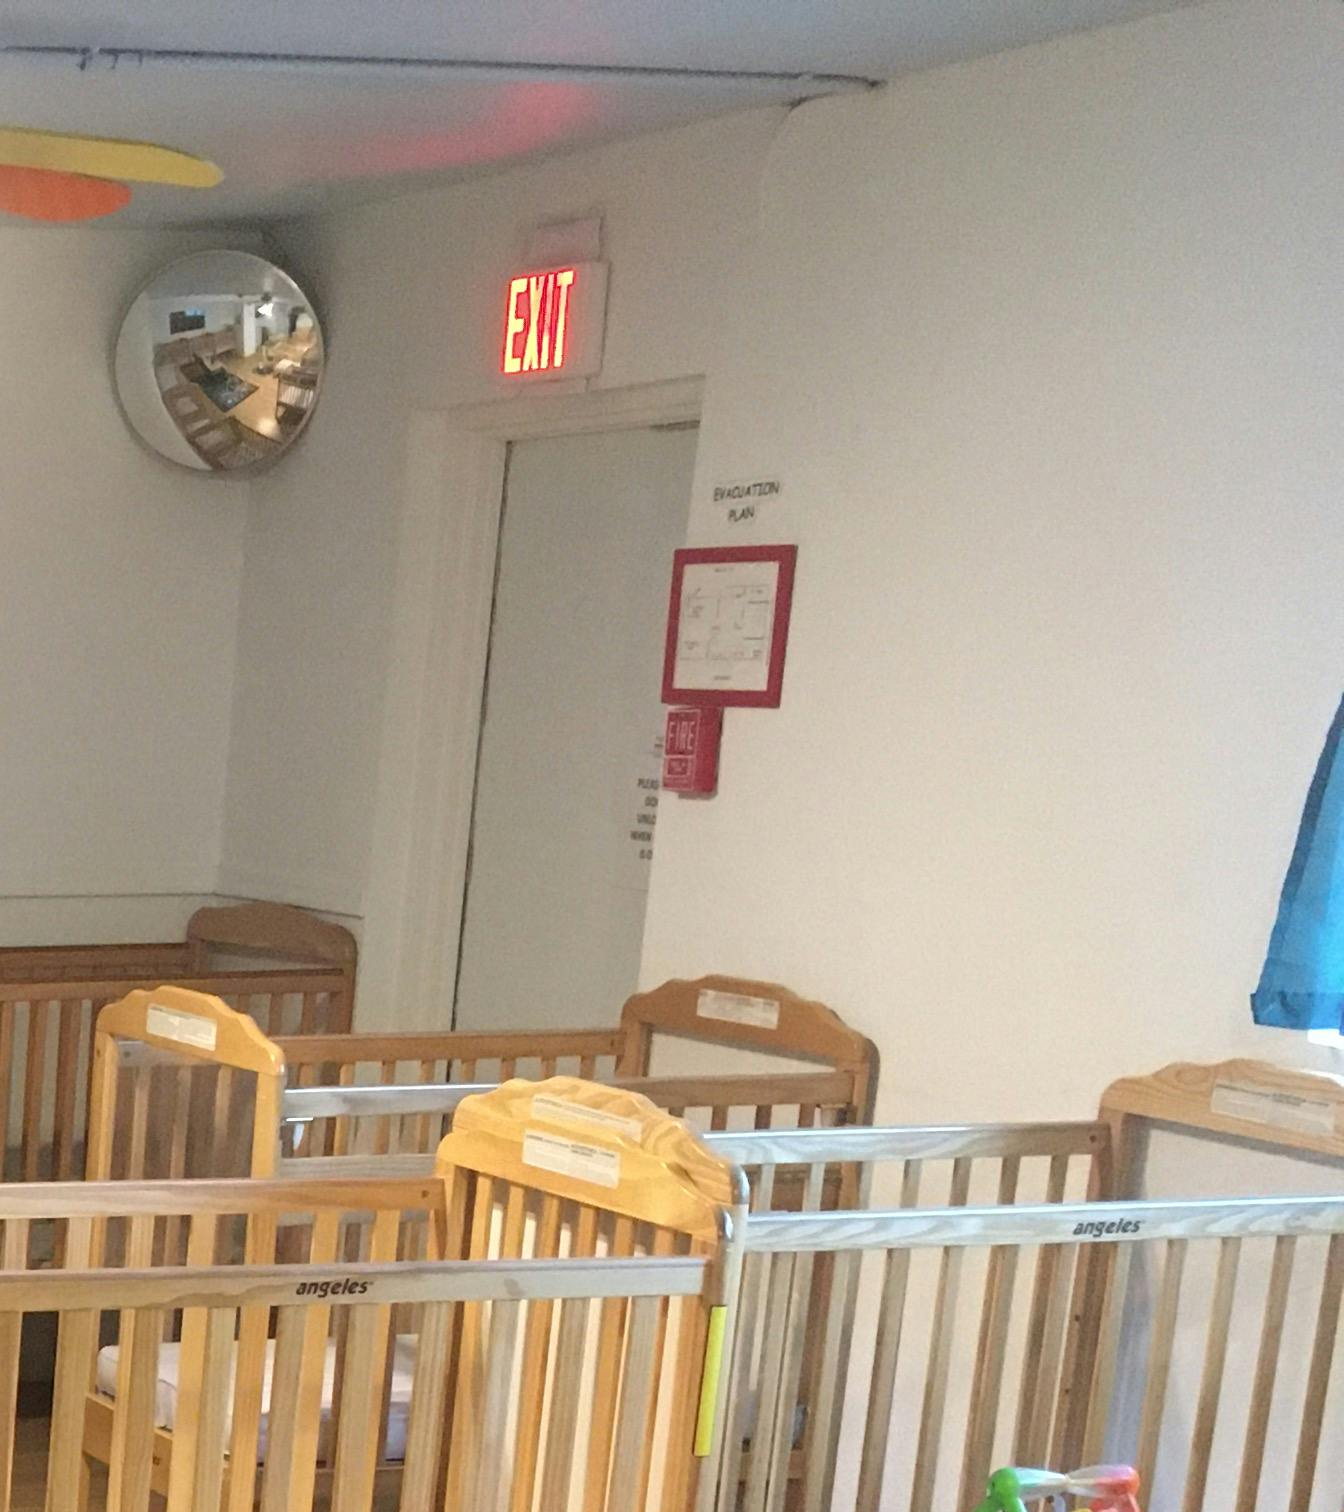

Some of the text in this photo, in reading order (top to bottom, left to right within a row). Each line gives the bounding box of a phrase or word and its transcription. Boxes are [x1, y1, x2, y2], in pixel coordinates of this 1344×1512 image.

[503, 269, 574, 373] EXIT
[713, 481, 780, 501] EVACUATION
[728, 505, 755, 522] PLAN
[667, 721, 695, 751] FIRE
[1073, 1218, 1141, 1238] angeles
[296, 1278, 368, 1298] angeles
